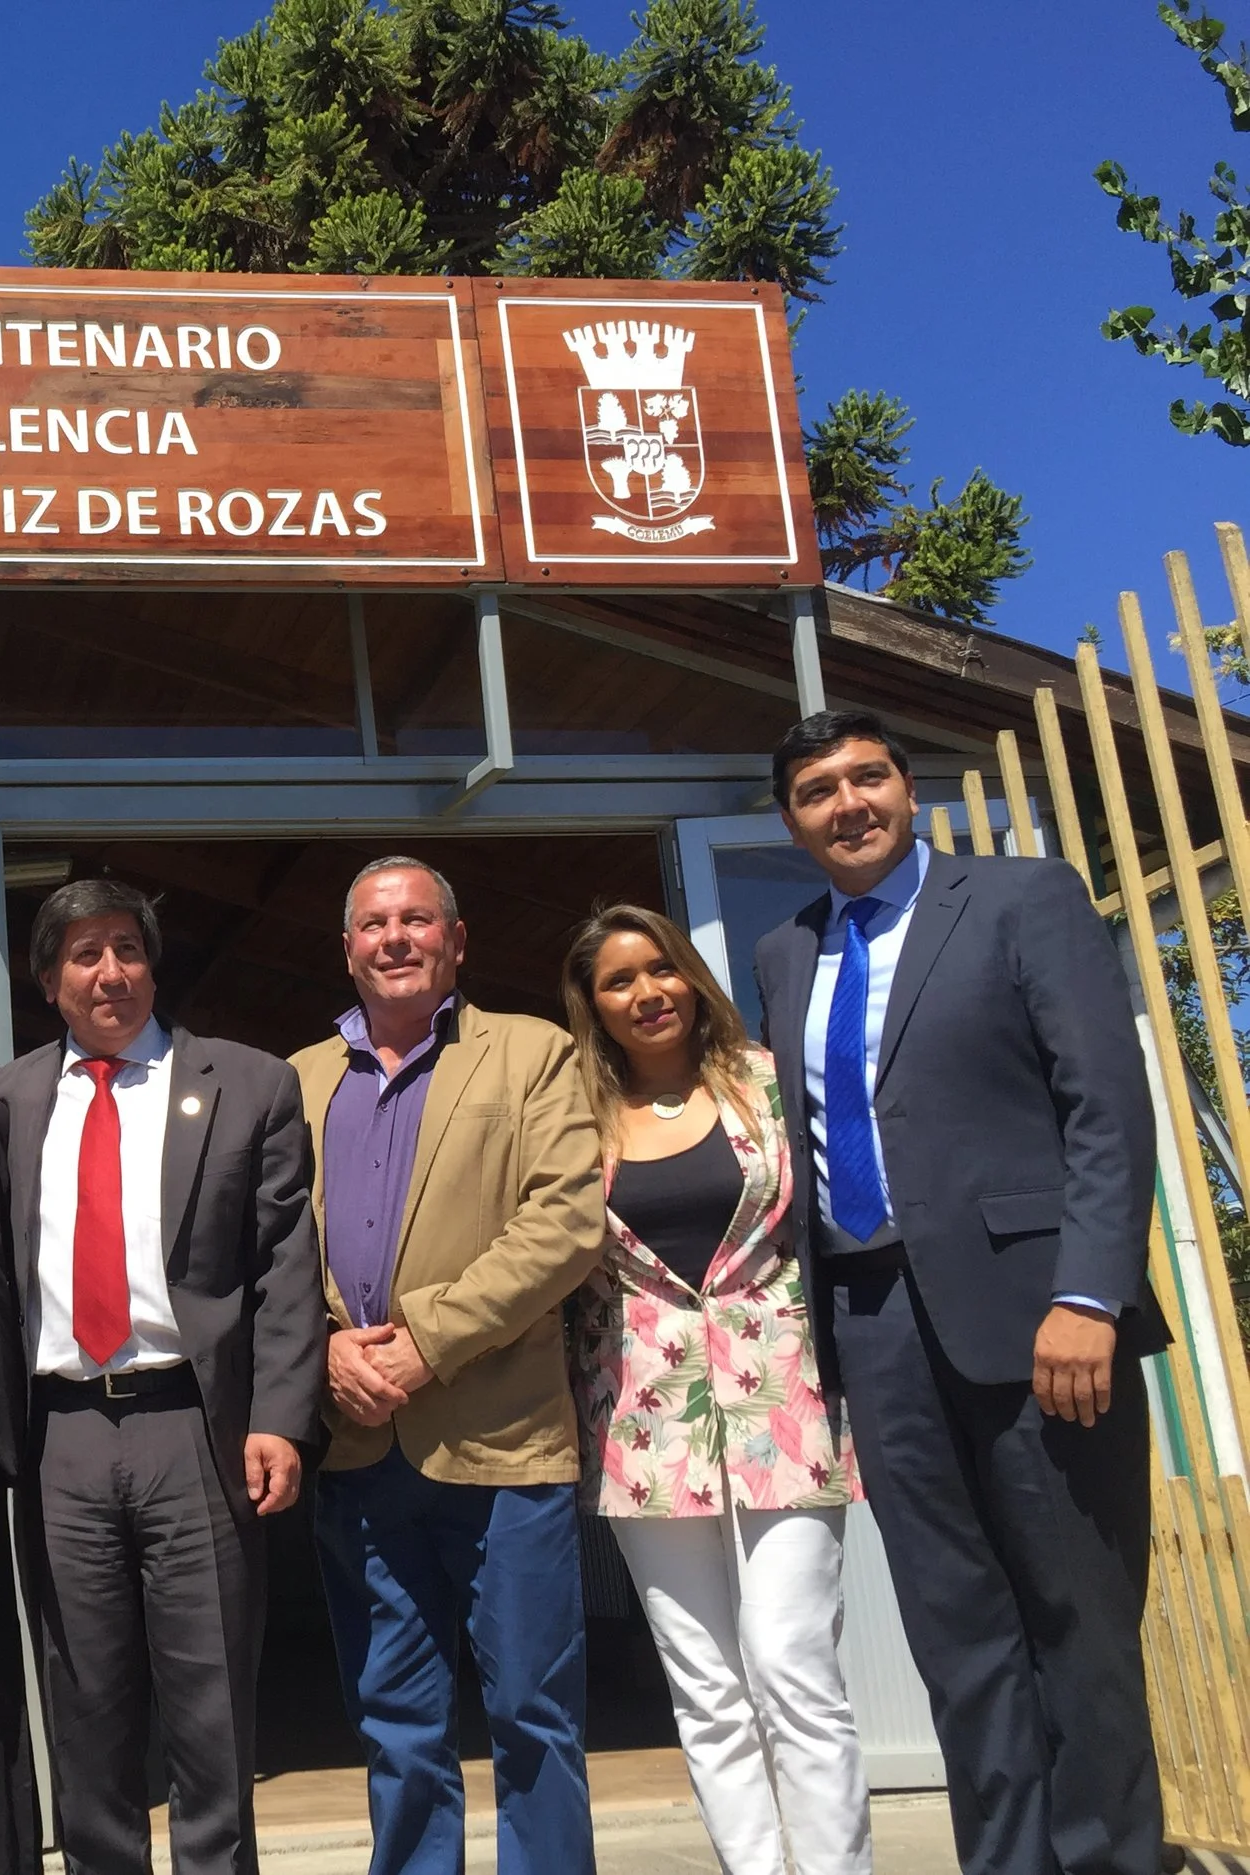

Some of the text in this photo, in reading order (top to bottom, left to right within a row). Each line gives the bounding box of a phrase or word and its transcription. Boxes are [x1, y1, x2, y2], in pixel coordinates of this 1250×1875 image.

[76, 489, 161, 535] DE
[176, 491, 388, 537] ROZAS
[627, 524, 685, 542] COELEMU
